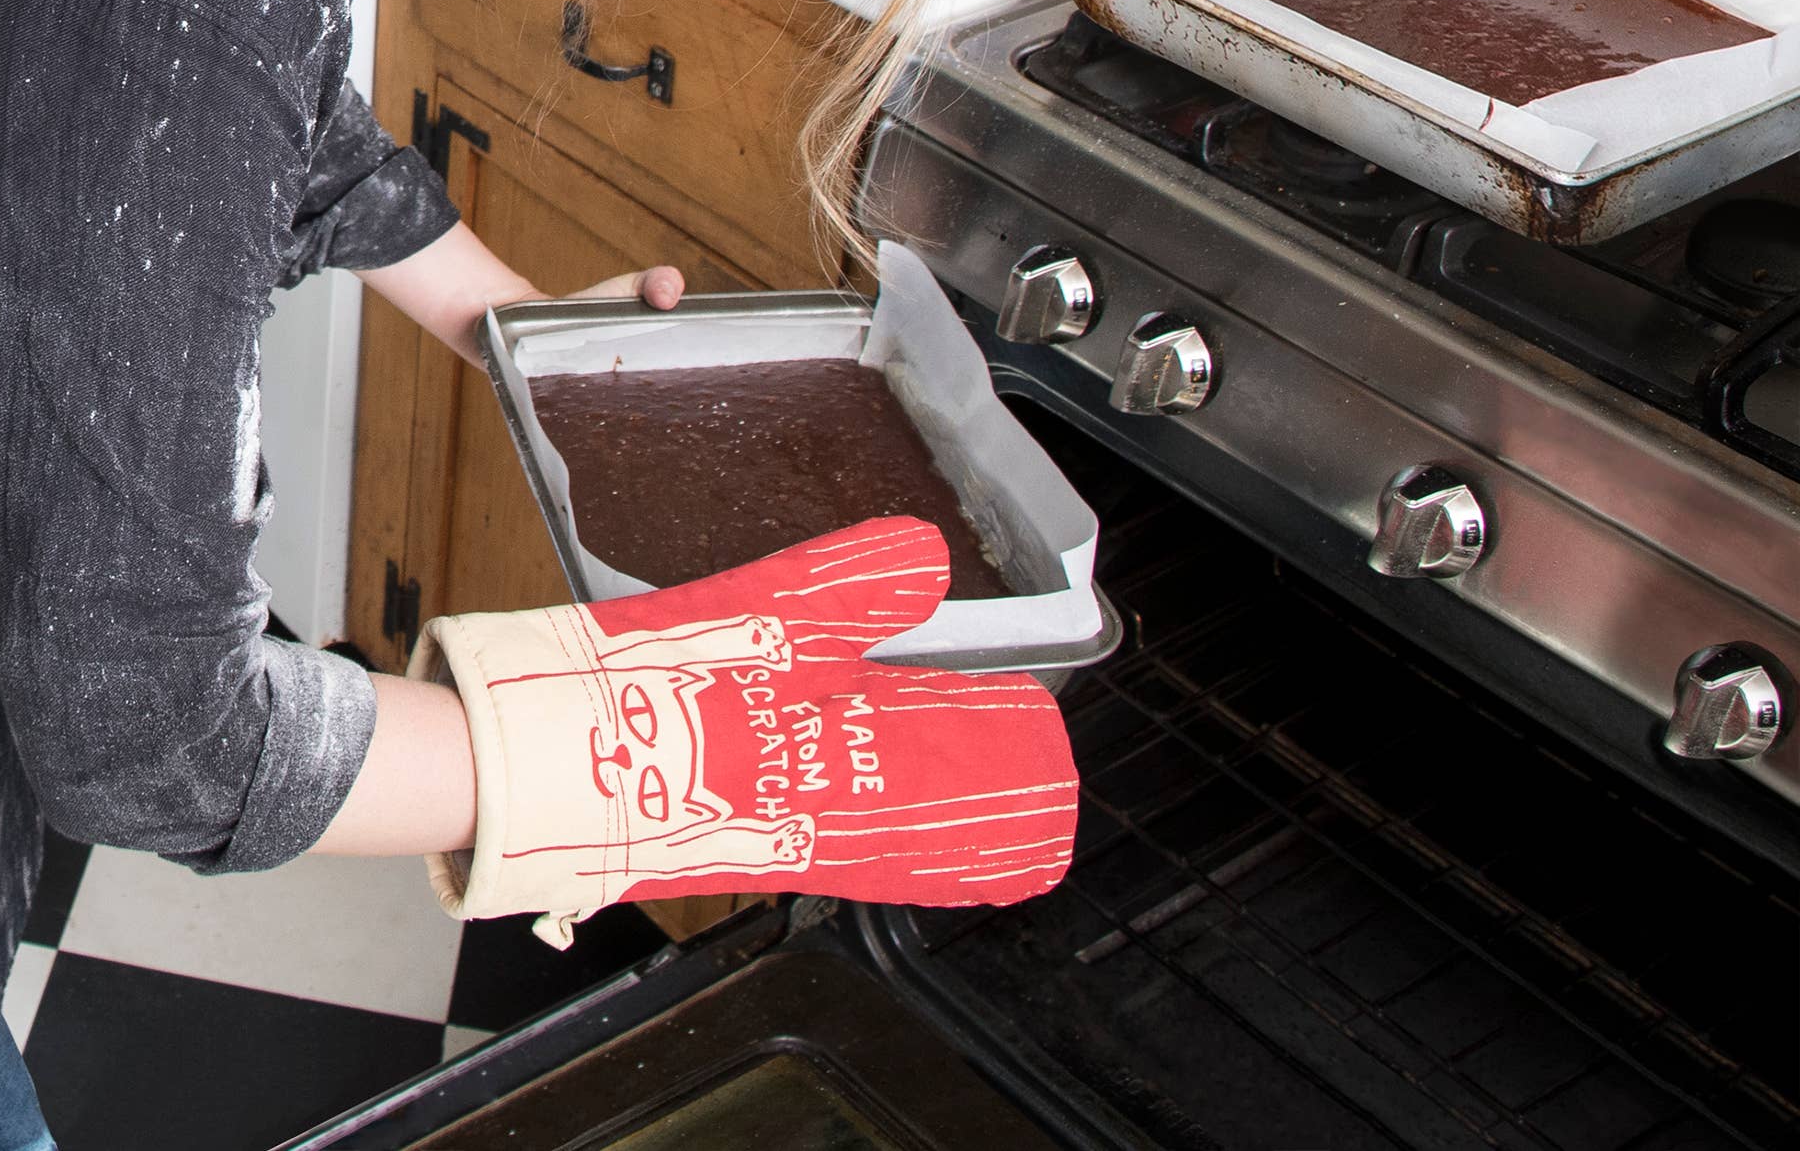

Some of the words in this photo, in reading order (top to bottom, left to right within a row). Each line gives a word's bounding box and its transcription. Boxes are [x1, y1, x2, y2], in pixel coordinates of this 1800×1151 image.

[731, 669, 790, 819] SCRATCH
[781, 701, 830, 791] FROM
[831, 694, 884, 794] MADE
